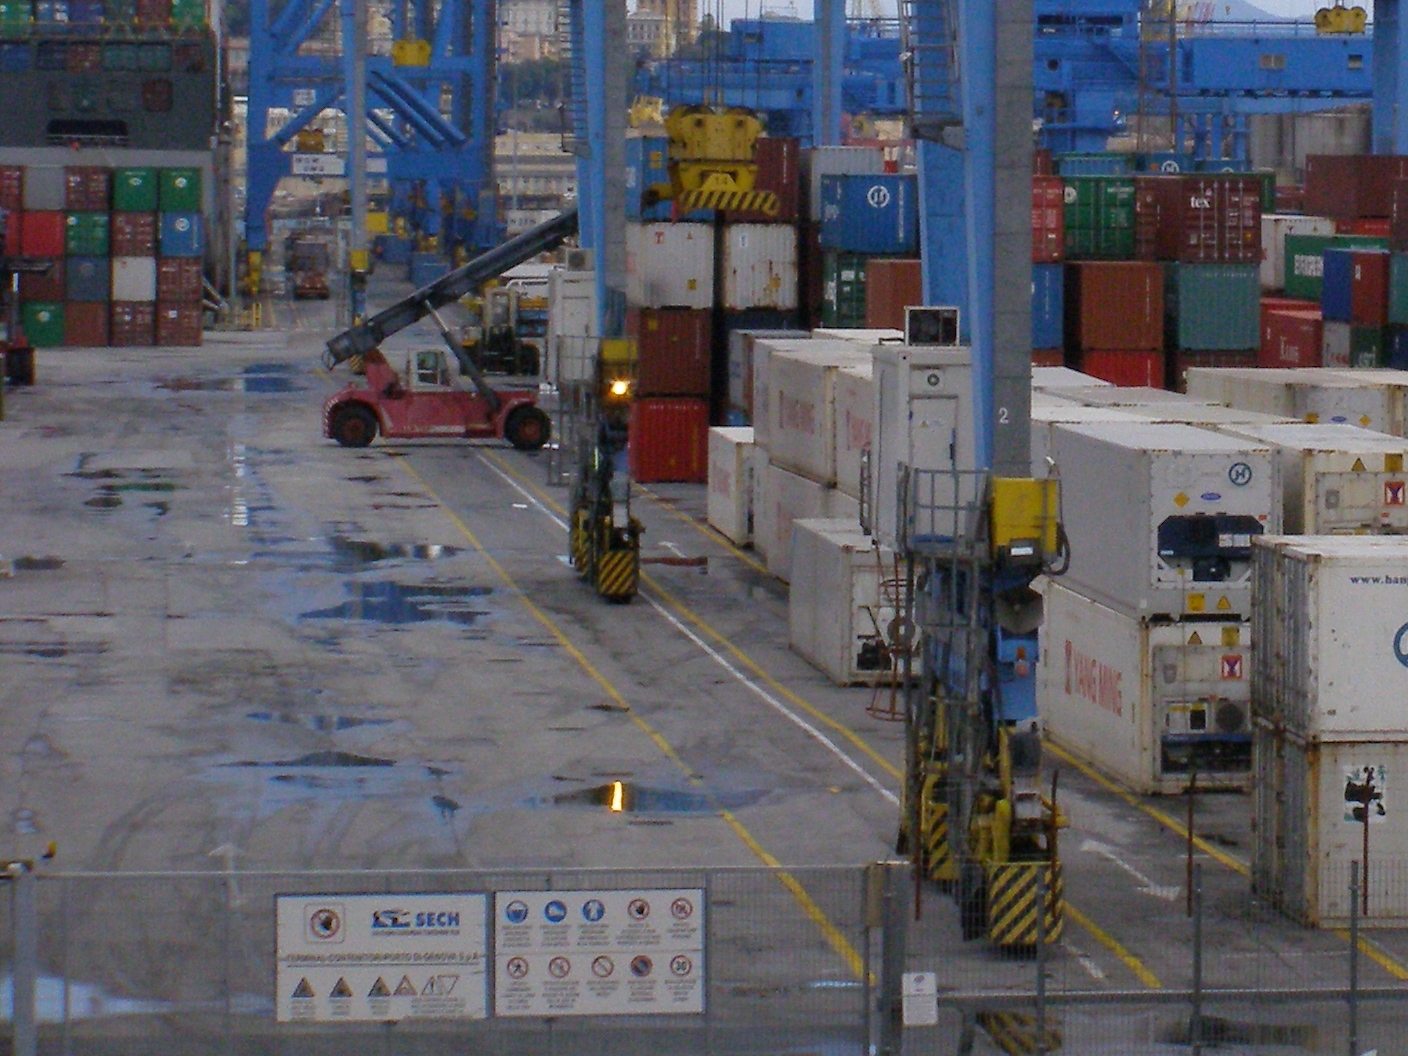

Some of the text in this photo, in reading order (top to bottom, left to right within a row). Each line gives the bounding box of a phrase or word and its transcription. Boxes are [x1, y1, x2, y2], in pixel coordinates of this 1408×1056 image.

[1190, 195, 1211, 209] tex
[999, 407, 1009, 424] 2
[415, 911, 461, 927] SECH
